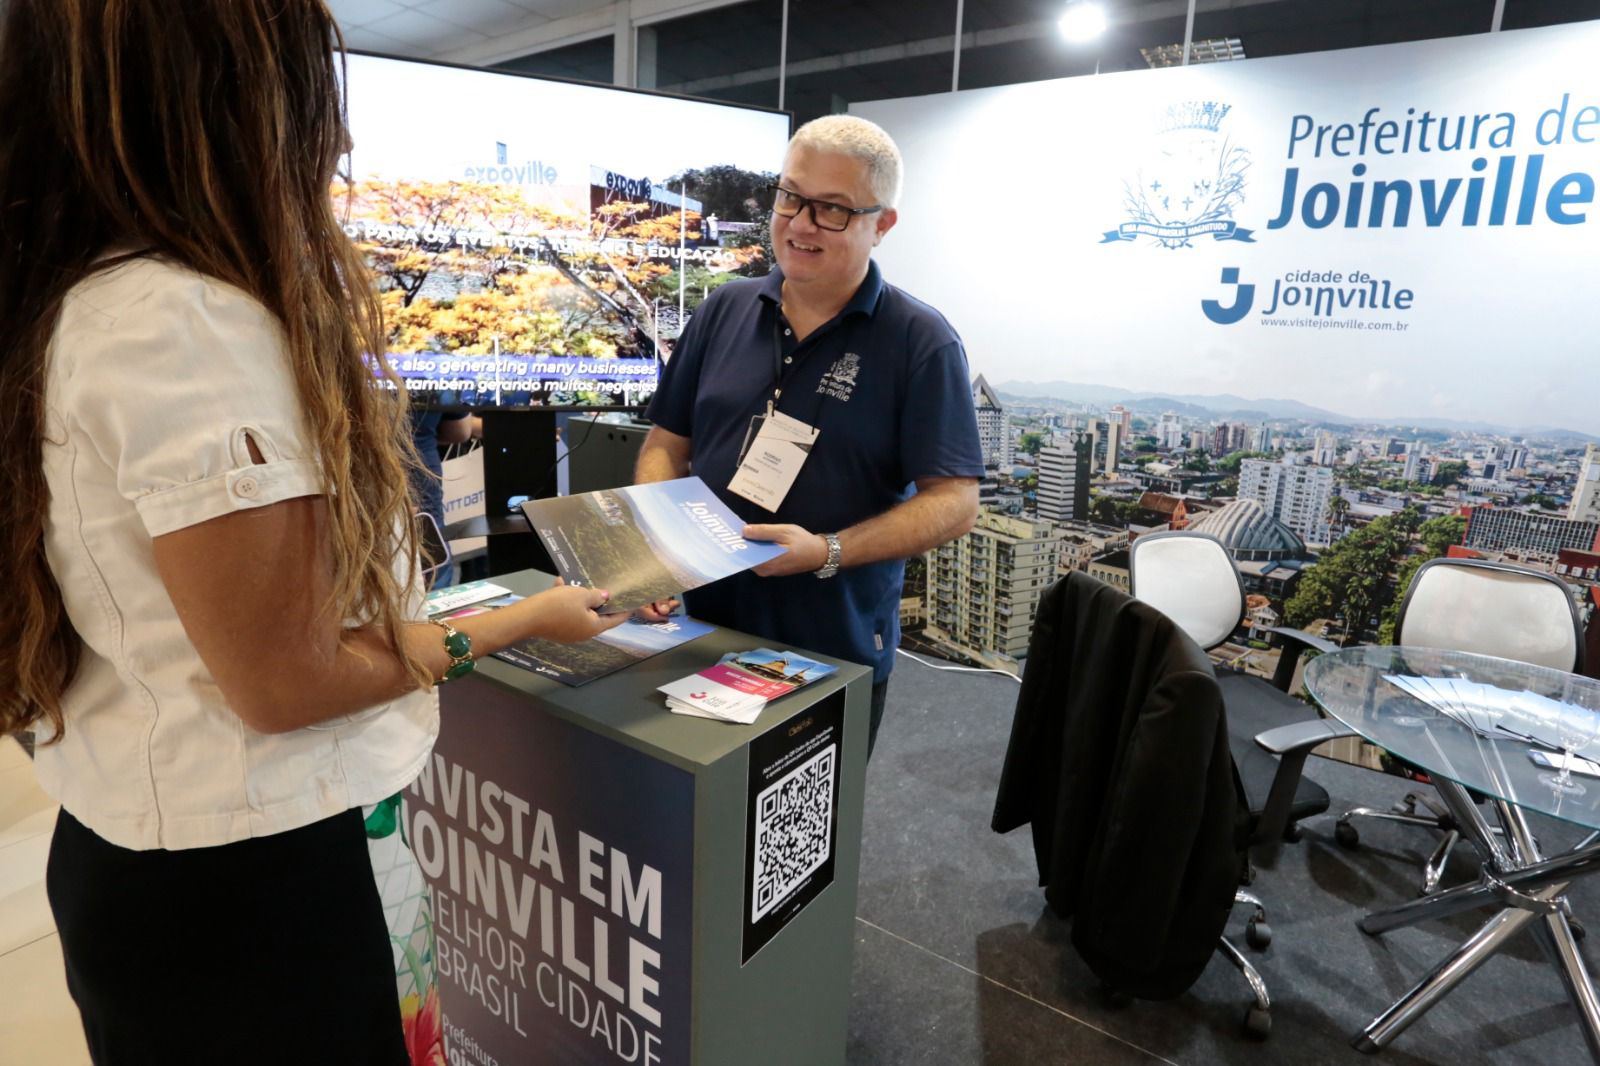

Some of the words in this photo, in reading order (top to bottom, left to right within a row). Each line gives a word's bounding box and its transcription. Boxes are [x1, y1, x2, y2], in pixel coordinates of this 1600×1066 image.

[1287, 107, 1516, 159] Prefeitura
[1535, 93, 1600, 146] de
[464, 160, 558, 185] expoville
[1267, 154, 1596, 230] Joinville
[365, 226, 418, 243] PARA
[424, 228, 450, 244] OS
[648, 246, 736, 263] EDUCAÇÃO
[1285, 269, 1343, 283] cidade
[1348, 270, 1371, 283] de
[1262, 278, 1415, 317] Joinville
[1260, 317, 1410, 331] www.visitejoinville.com.br
[402, 357, 436, 372] also
[440, 360, 528, 376] generating
[532, 362, 576, 376] many
[577, 361, 657, 376] businesses
[406, 377, 475, 391] também
[544, 379, 595, 393] muitos
[816, 385, 850, 402] Jonville
[685, 501, 748, 551] Joinville
[411, 752, 564, 884] NVISTA
[578, 829, 662, 940] EM
[436, 934, 528, 1038] BRASIL
